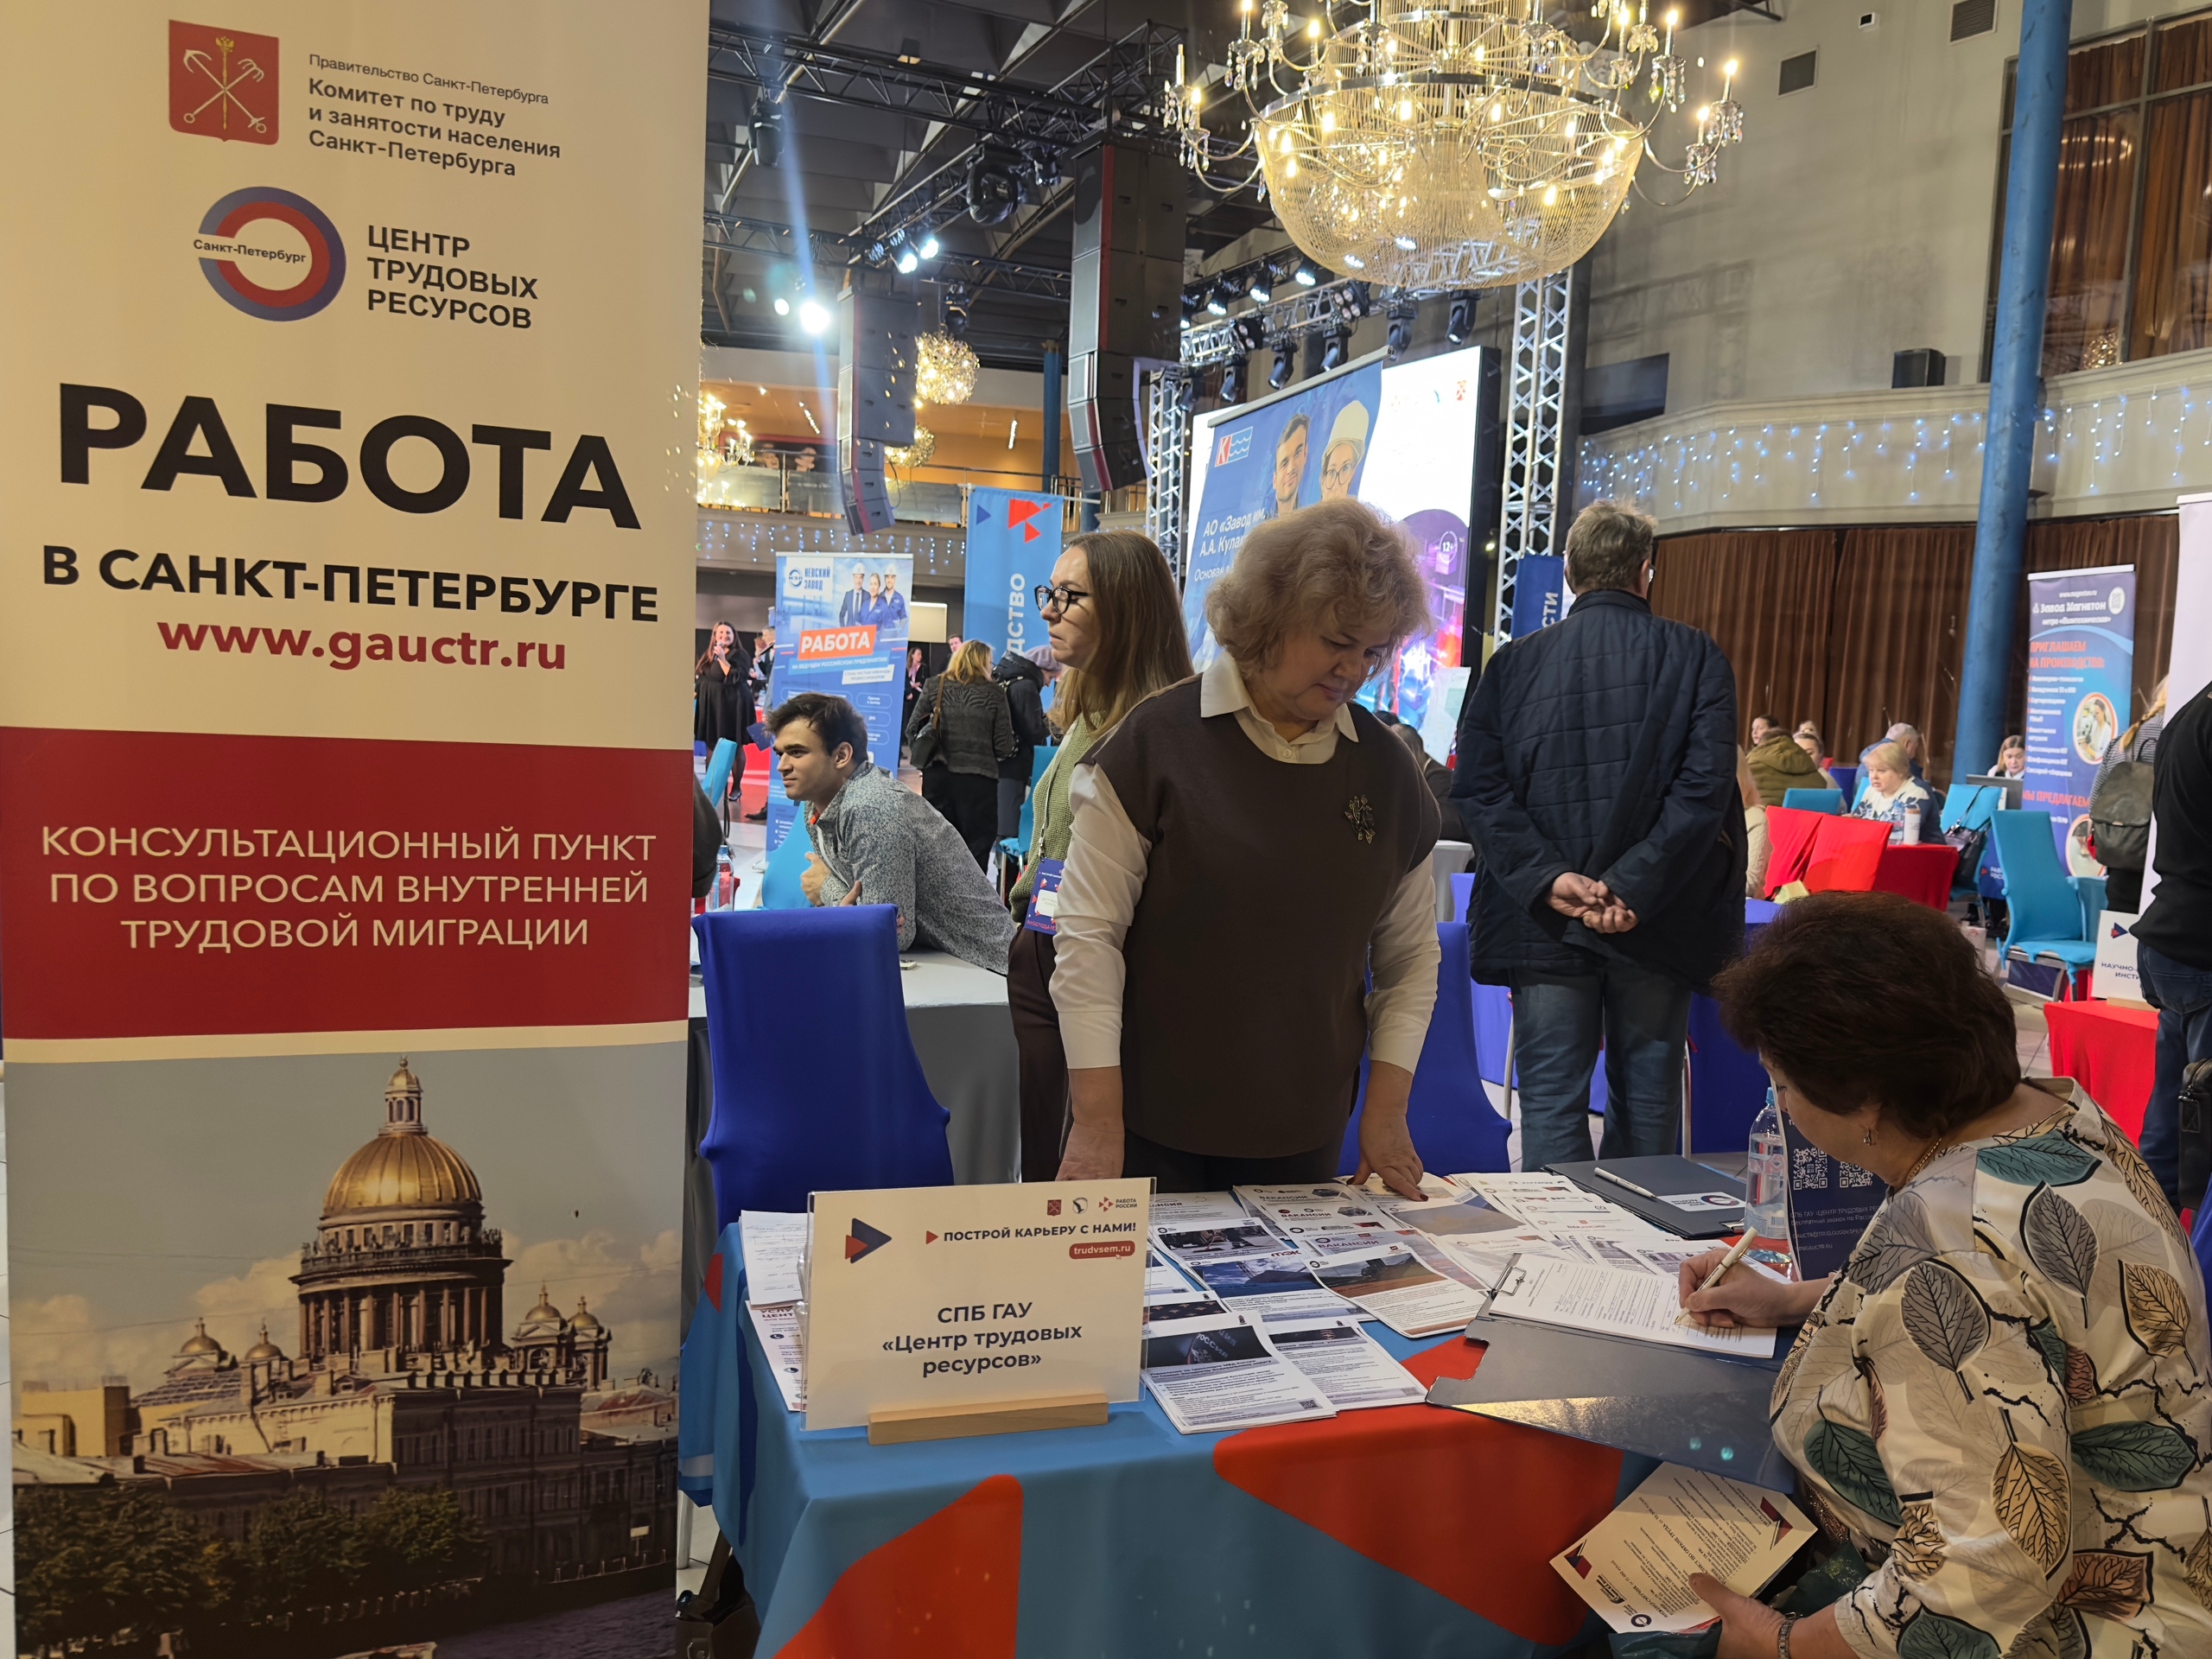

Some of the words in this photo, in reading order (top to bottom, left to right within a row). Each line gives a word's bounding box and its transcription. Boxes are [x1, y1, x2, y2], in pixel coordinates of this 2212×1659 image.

[309, 54, 419, 84] Правительство
[423, 73, 550, 105] Санкт-Петербурга
[309, 79, 404, 109] Комитет
[410, 98, 437, 115] по
[442, 101, 505, 129] труду
[308, 106, 322, 121] и
[327, 111, 442, 140] занятости
[447, 129, 561, 159] населения
[308, 130, 516, 176] Санкт-Петербурга
[193, 238, 307, 264] Санкт-Петербург
[368, 225, 470, 258] ЦЕНТР
[368, 257, 538, 301] ТРУДОВЫХ
[368, 289, 532, 329] РЕСУРСОВ
[59, 383, 642, 530] РАБОТА
[1203, 518, 1218, 537] АО
[1219, 514, 1250, 533] «Завод
[1253, 507, 1266, 524] им.
[1199, 540, 1216, 557] А.А.
[1442, 542, 1454, 552] 12+
[43, 545, 79, 585] В
[99, 549, 658, 622] САНКТ-ПЕТЕРБУРГЕ
[804, 567, 830, 578] НЕВСКИЙ
[804, 580, 823, 591] ЗАВОД
[1194, 568, 1224, 582] Основан
[157, 622, 565, 671] www.gauctr.ru
[801, 632, 870, 653] РАБОТА
[42, 825, 519, 863] КОНСУЛЬТАЦИОННЫЙ
[532, 834, 657, 861] ПУНКТ
[50, 874, 118, 903] ПО
[133, 874, 384, 903] ВОПРОСАМ
[397, 870, 648, 903] ВНУТРЕННЕЙ
[121, 913, 359, 954] ТРУДОВОЙ
[372, 918, 588, 950] МИГРАЦИИ
[1838, 1206, 1869, 1215] ТРУДОВЫХ
[944, 1227, 1011, 1242] ПОСТРОЙ
[1014, 1225, 1077, 1237] КАРЬЕРУ
[1080, 1225, 1089, 1234] С
[1092, 1223, 1136, 1234] НАМИ!
[1318, 1240, 1380, 1249] ВАКАНСИИ
[1073, 1244, 1131, 1255] trudvsem.ru
[938, 1306, 985, 1324] СПБ
[992, 1301, 1033, 1320] ГАУ
[881, 1331, 968, 1354] «Центр
[974, 1325, 1083, 1350] трудовых
[922, 1352, 1042, 1378] ресурсов»
[1662, 1523, 1675, 1538] ТРУДА
[1674, 1536, 1689, 1554] ОХРАНЕ
